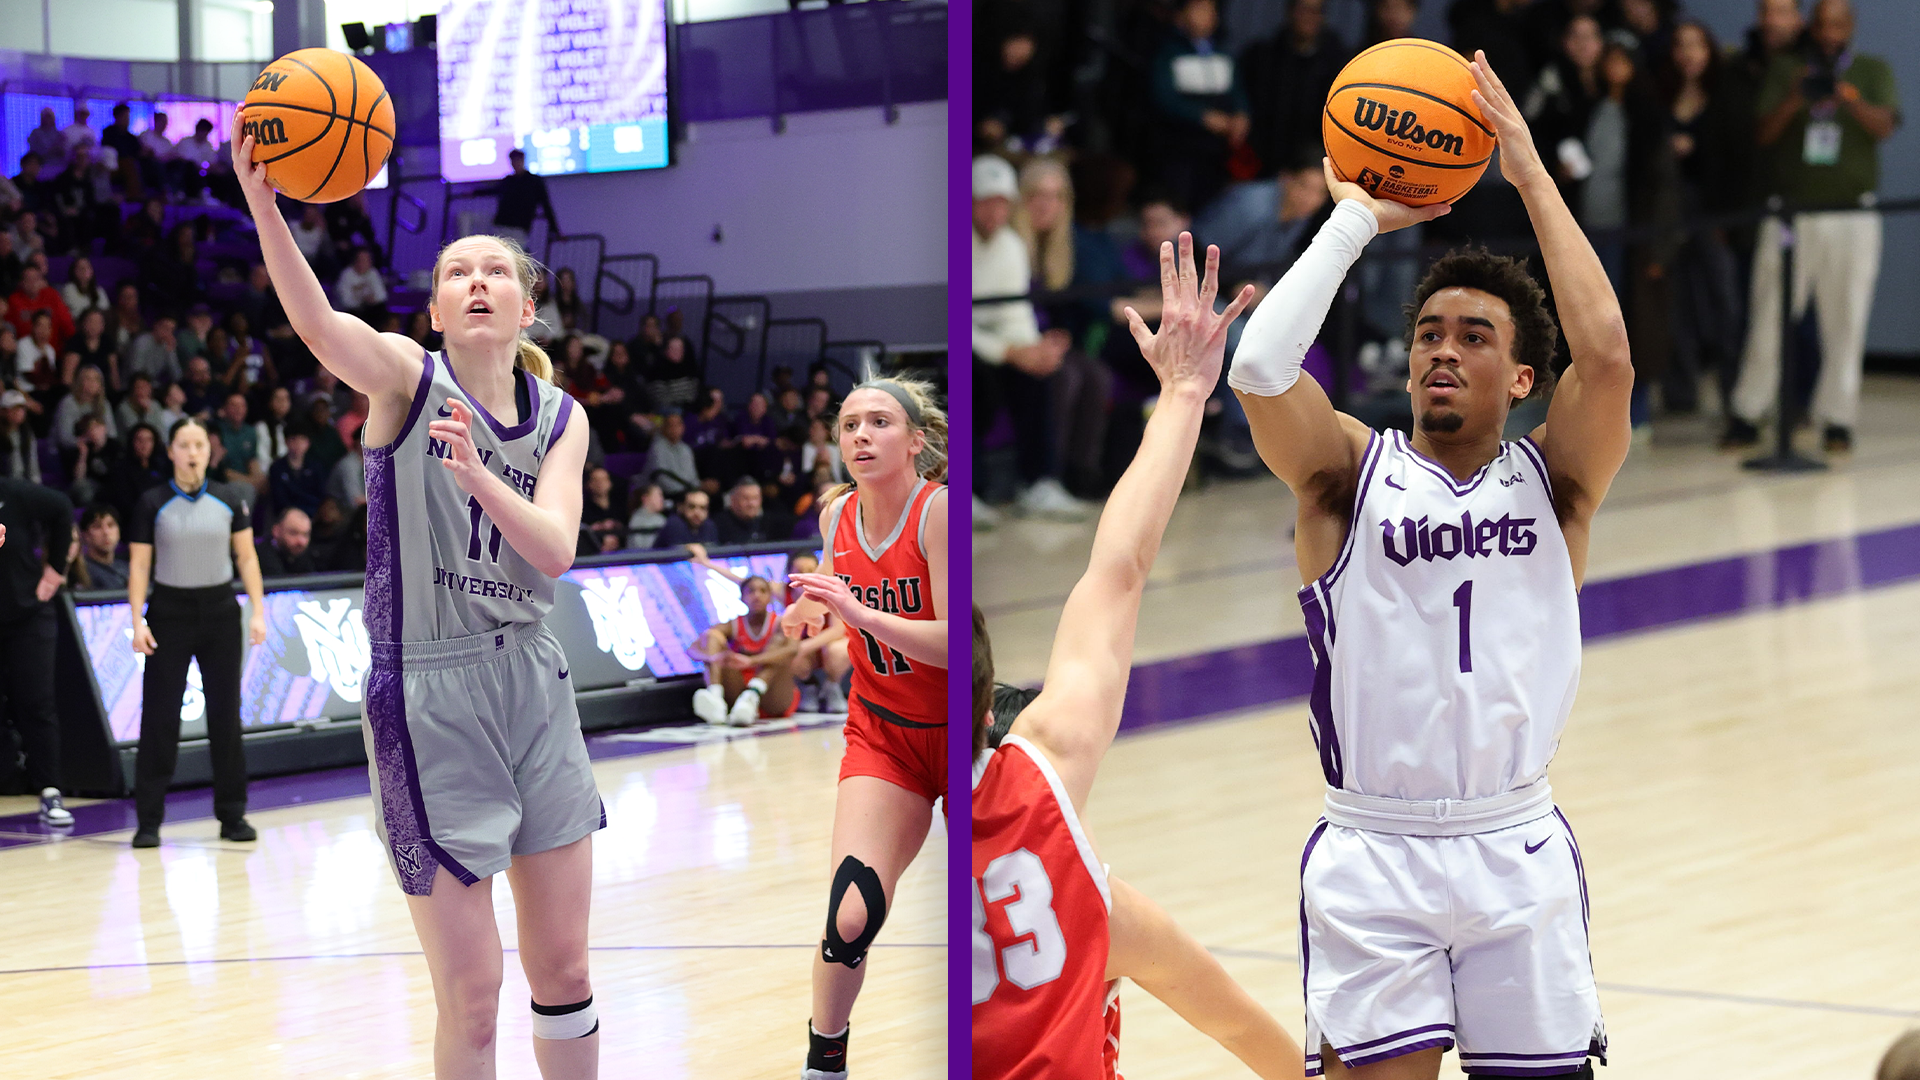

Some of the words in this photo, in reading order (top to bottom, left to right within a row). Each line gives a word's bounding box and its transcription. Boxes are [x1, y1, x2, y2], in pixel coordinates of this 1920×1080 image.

[1354, 97, 1463, 156] Wilson
[1387, 138, 1404, 147] EVO
[1406, 144, 1423, 152] NXT
[1381, 186, 1428, 198] CHAMPIONSHIP
[1382, 180, 1438, 195] BASKETBALL
[427, 436, 493, 467] NW
[502, 464, 537, 498] YOR
[1379, 509, 1537, 567] Violets
[1453, 580, 1473, 674] 1
